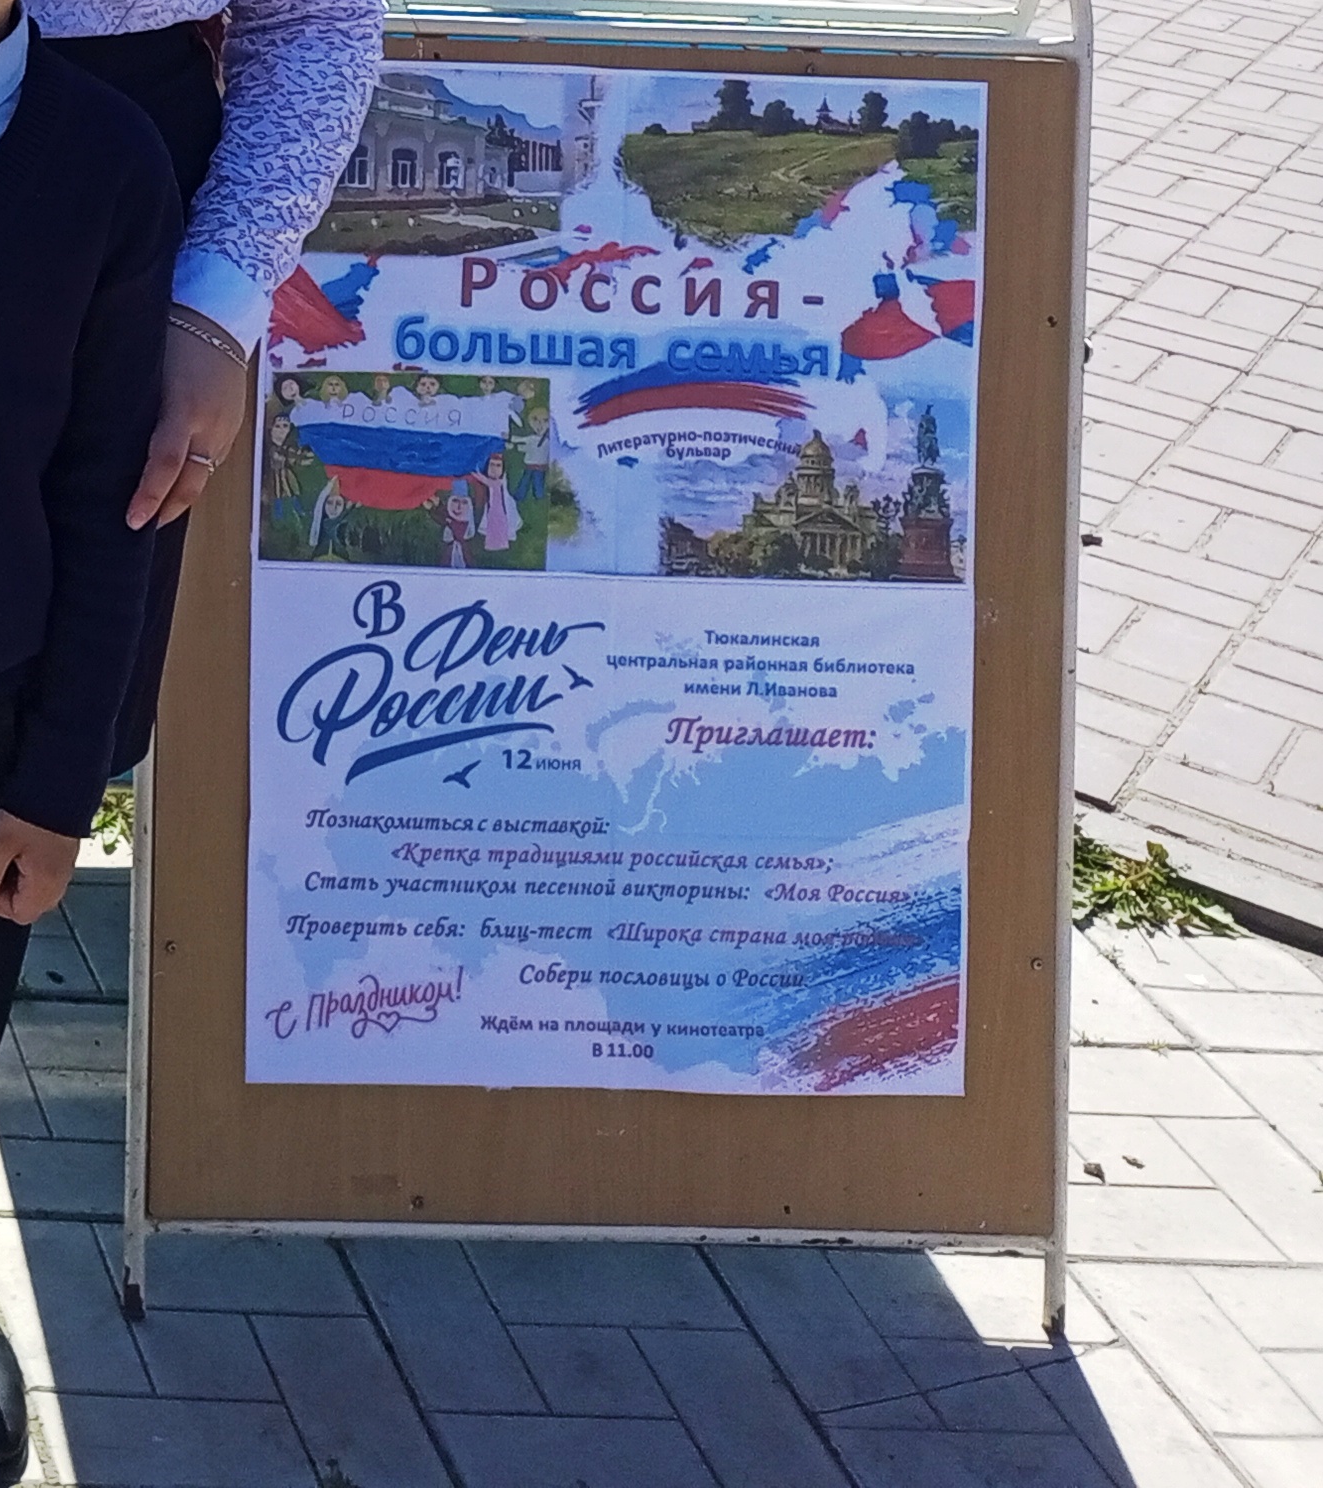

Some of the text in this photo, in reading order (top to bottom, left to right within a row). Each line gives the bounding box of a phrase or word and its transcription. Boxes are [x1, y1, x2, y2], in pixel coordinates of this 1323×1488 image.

[396, 315, 829, 376] большая семья
[343, 404, 461, 427] РОССИЯ
[597, 429, 801, 460] Литературно-поэтический
[665, 442, 730, 460] бульвар
[354, 581, 605, 677] В День
[705, 630, 820, 648] Тюкалинская
[606, 654, 914, 676] центральная районная библиотека
[684, 681, 837, 701] имени Л.Иванова
[277, 644, 565, 764] России
[667, 716, 876, 751] Приглашает:
[502, 749, 581, 774] 12 июня
[306, 811, 609, 835] Познакомиться с выставкой:
[391, 843, 479, 867] «Крепка
[487, 847, 623, 869] традициями
[630, 851, 747, 870] российская
[306, 873, 378, 894] Стать
[385, 879, 514, 902] участником
[525, 881, 614, 897] песенной
[623, 881, 749, 903] викторины:
[765, 883, 826, 903] «Моя
[287, 915, 406, 939] Проверить
[413, 920, 464, 939] себя:
[480, 923, 591, 942] блиц-тест
[608, 923, 703, 948] «Широка
[712, 927, 786, 948] страна
[519, 964, 591, 987] Собери
[598, 969, 709, 990] пословицы
[717, 975, 726, 987] о
[481, 1013, 764, 1038] Ждём на площади у кинотеатра
[591, 1043, 654, 1059] В 11.00
